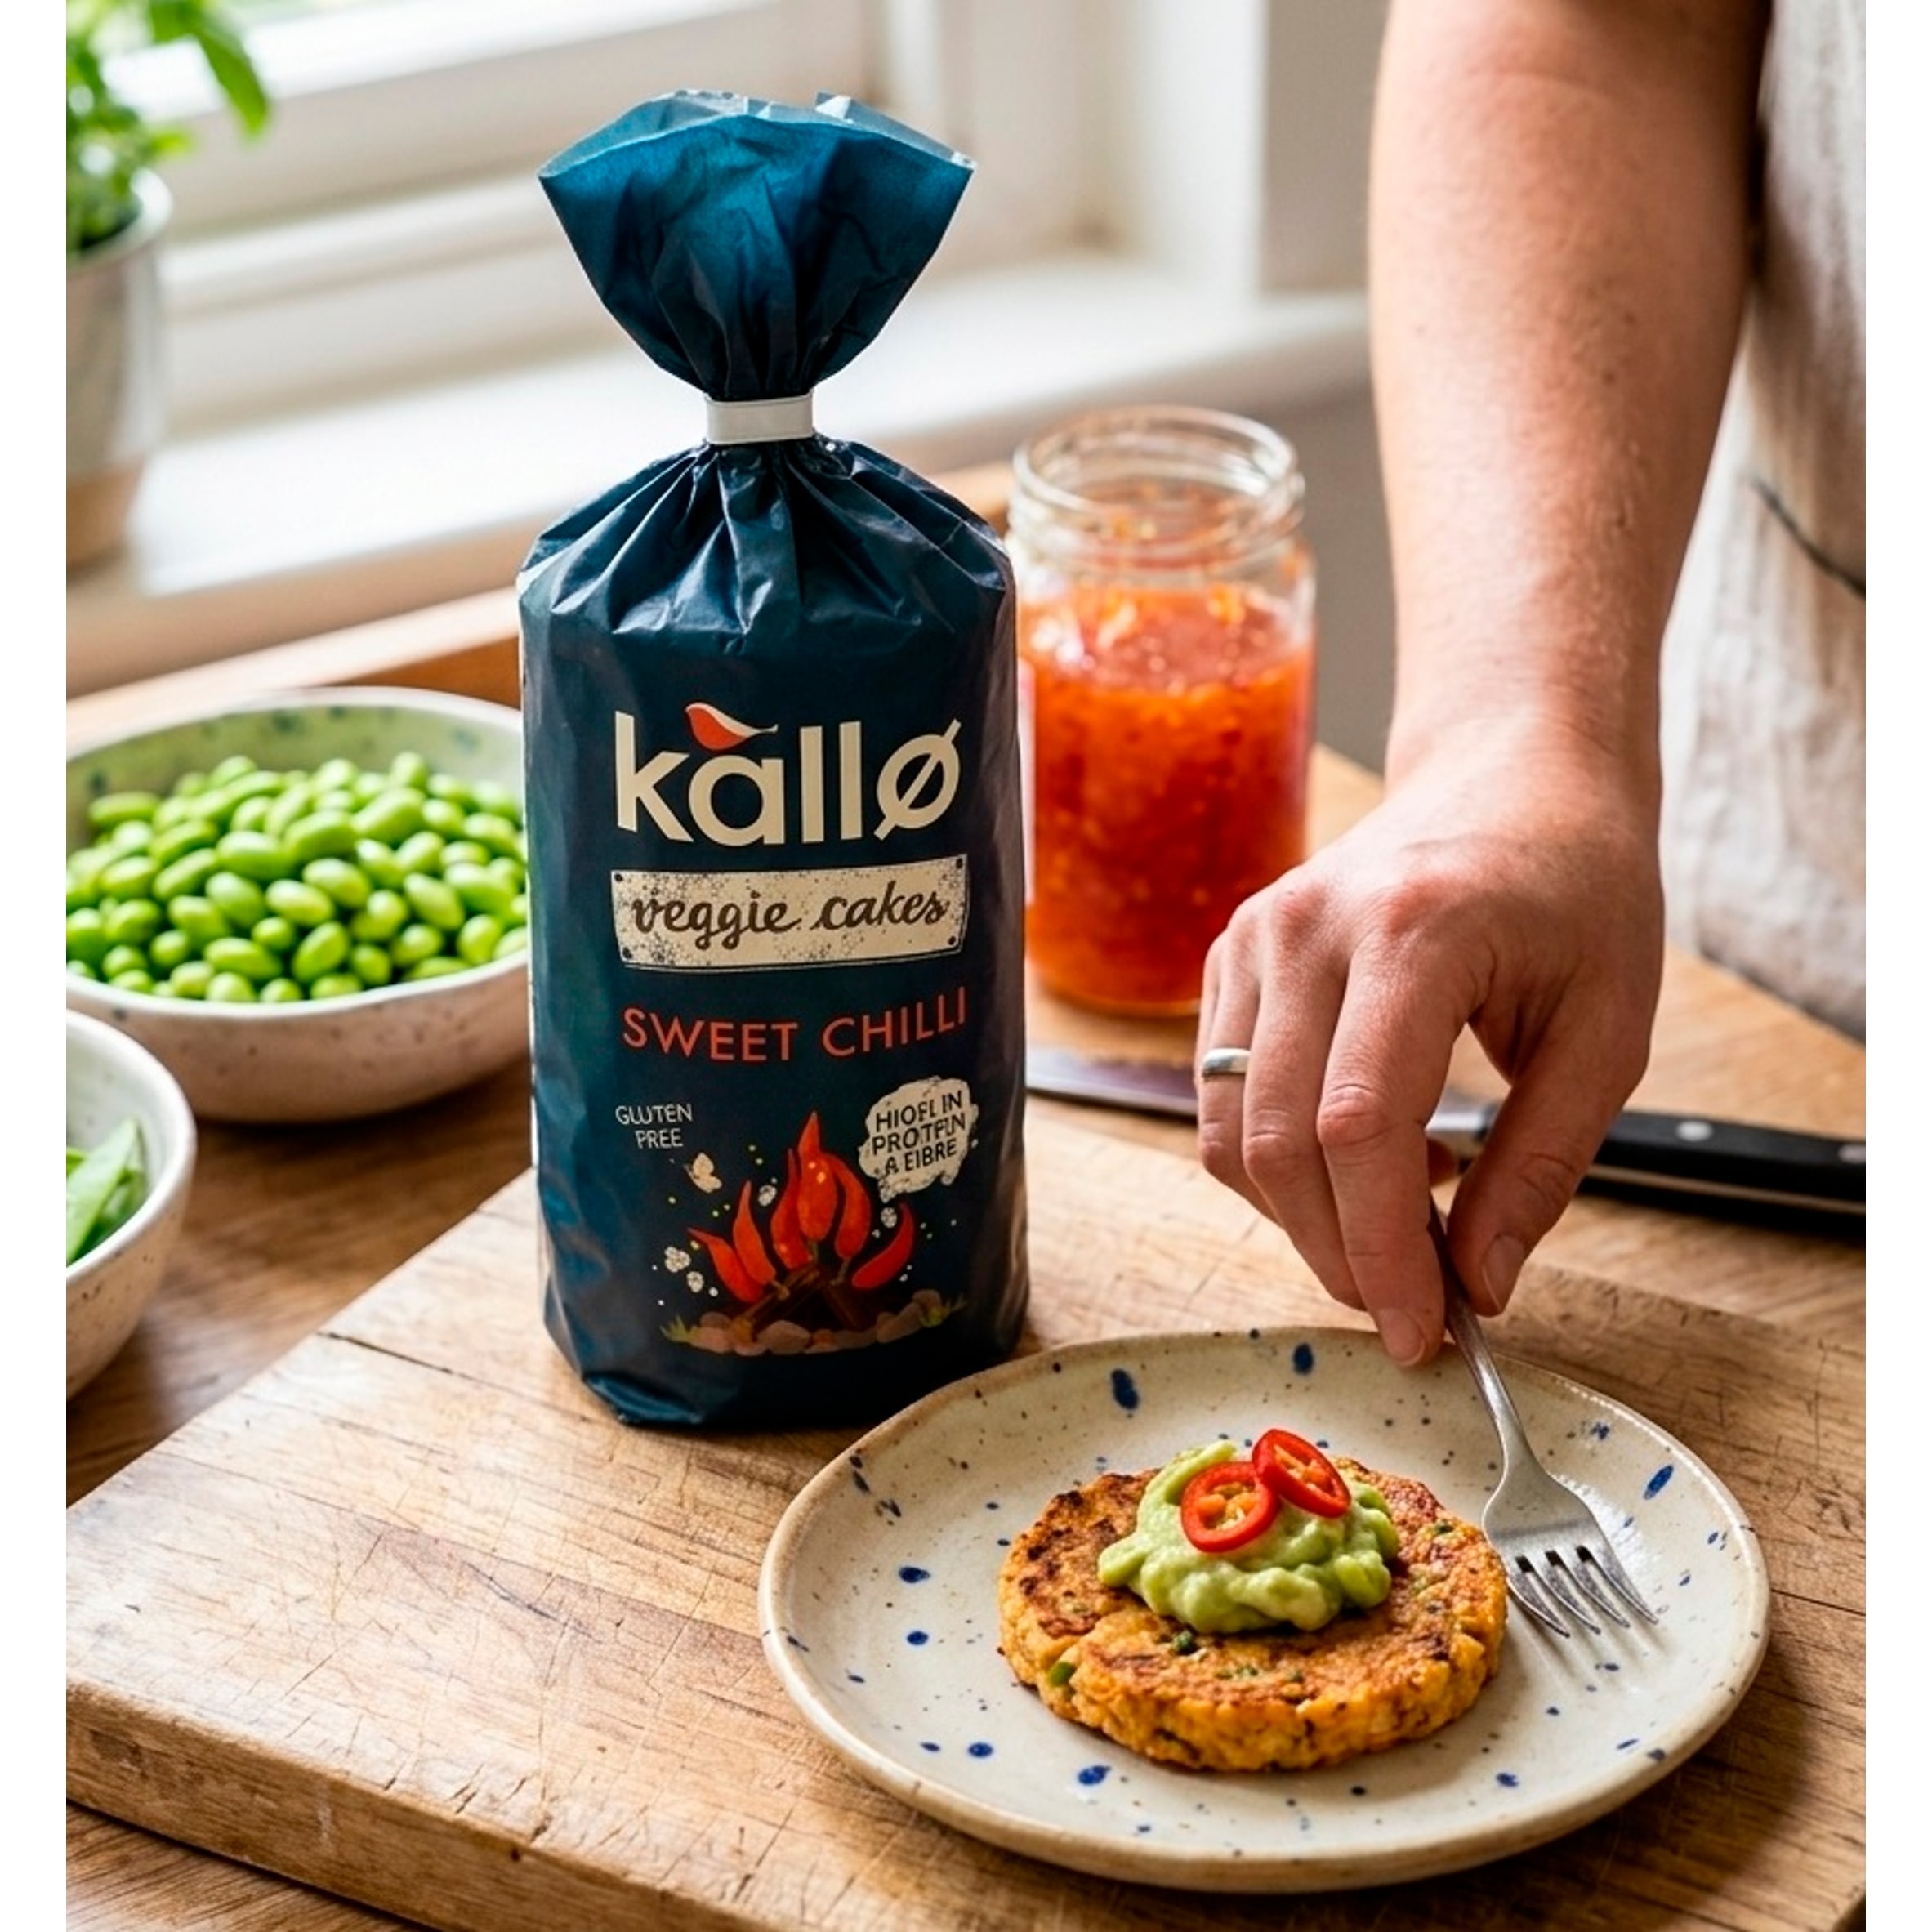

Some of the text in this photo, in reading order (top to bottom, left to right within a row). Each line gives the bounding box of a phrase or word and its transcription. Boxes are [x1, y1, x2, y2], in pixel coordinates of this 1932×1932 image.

[632, 881, 951, 949] veggie cakes
[622, 986, 966, 1061] SWEET CHILLI
[615, 1103, 693, 1125] GLUTEN
[942, 1090, 962, 1113] IN
